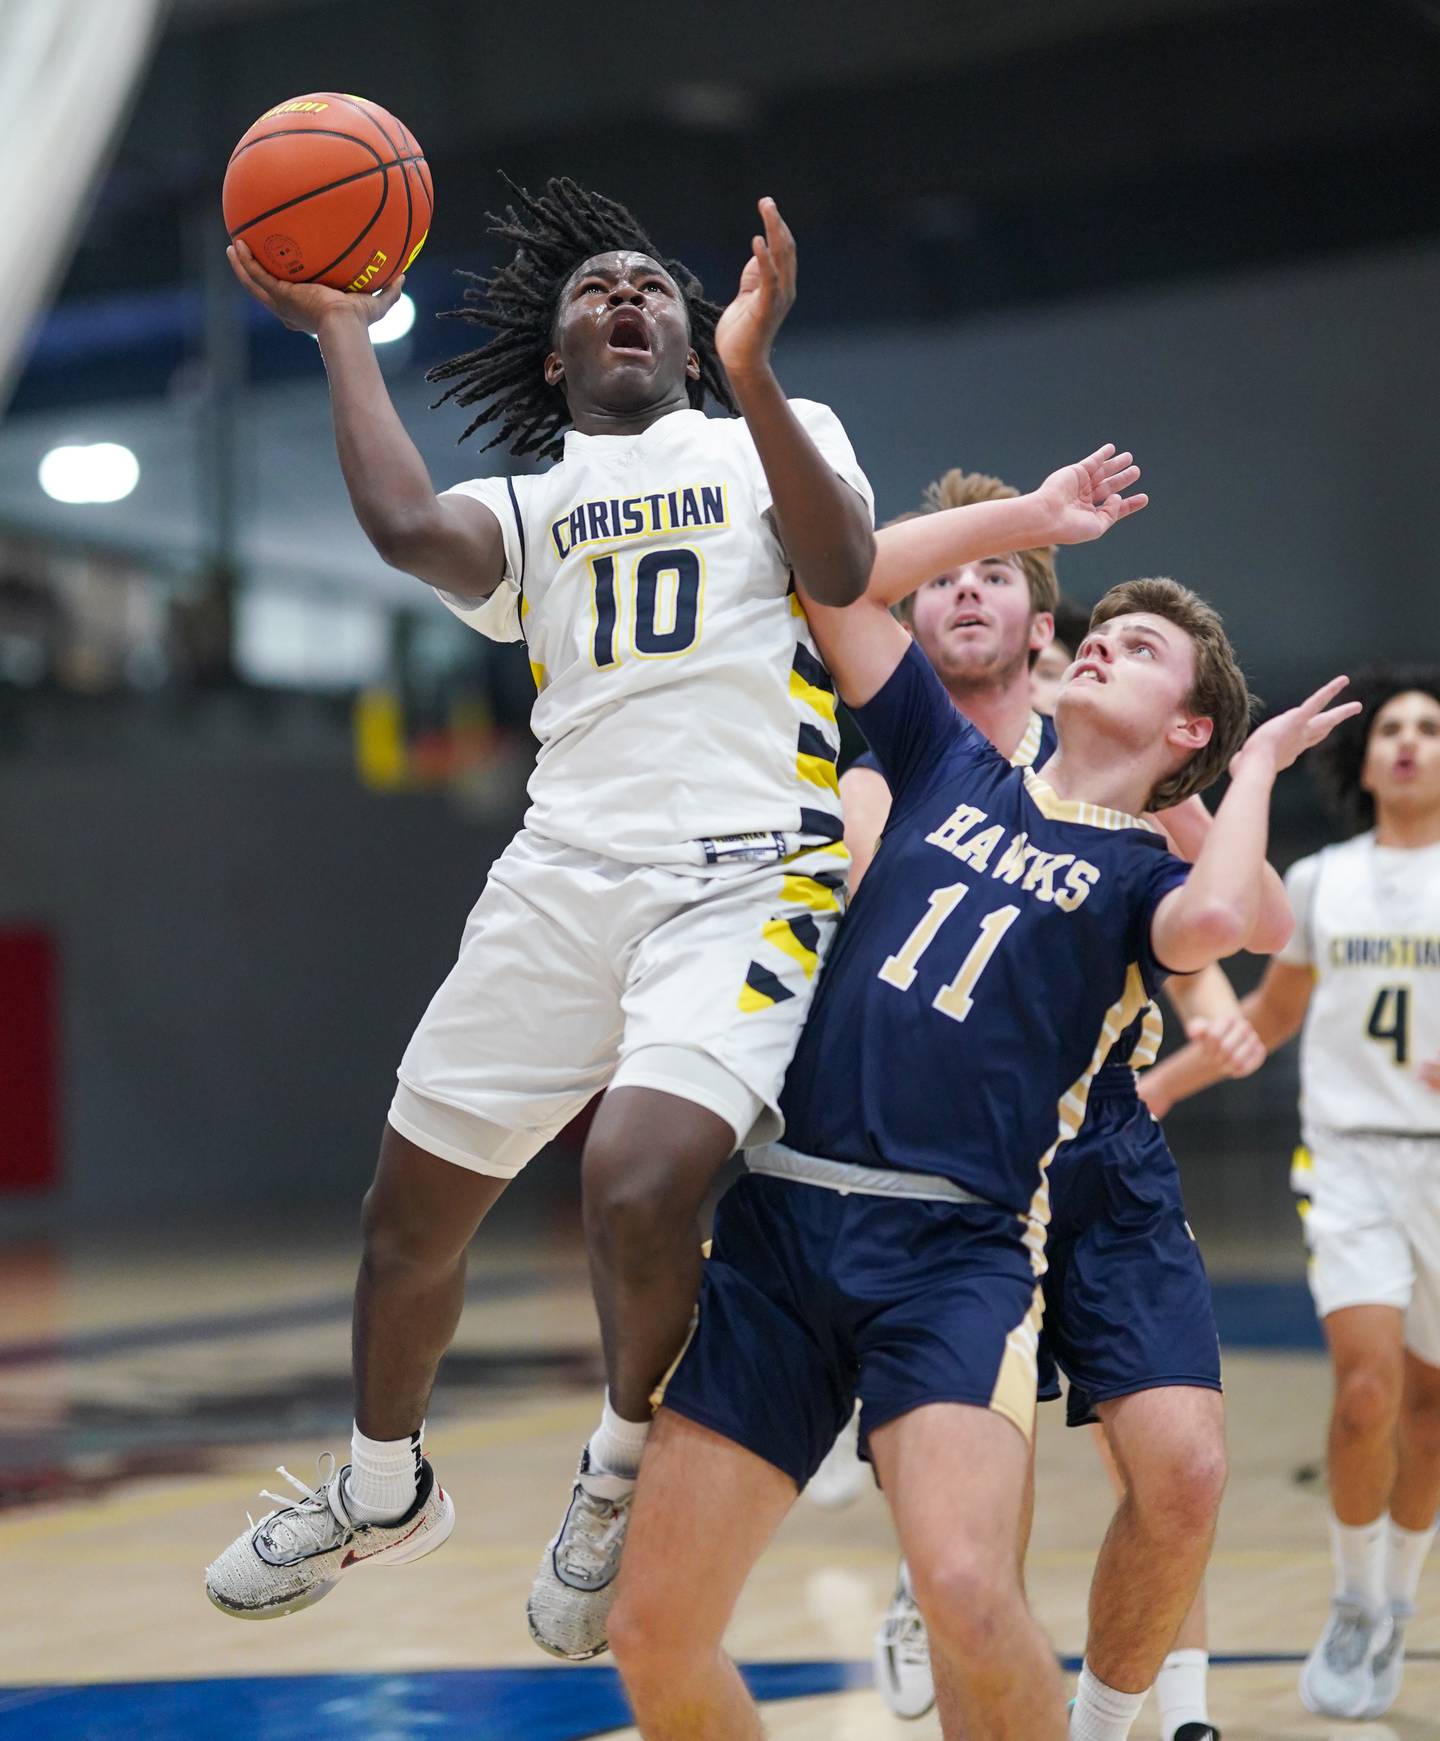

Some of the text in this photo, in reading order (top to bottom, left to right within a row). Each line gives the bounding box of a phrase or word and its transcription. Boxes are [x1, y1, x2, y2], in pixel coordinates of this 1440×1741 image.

[551, 484, 727, 560] CHRISTIAN
[590, 546, 703, 669] 10
[924, 803, 1100, 913] HAWKS
[877, 882, 1021, 1023] 11
[1330, 935, 1440, 969] CHRISTIA
[1366, 985, 1408, 1065] 4
